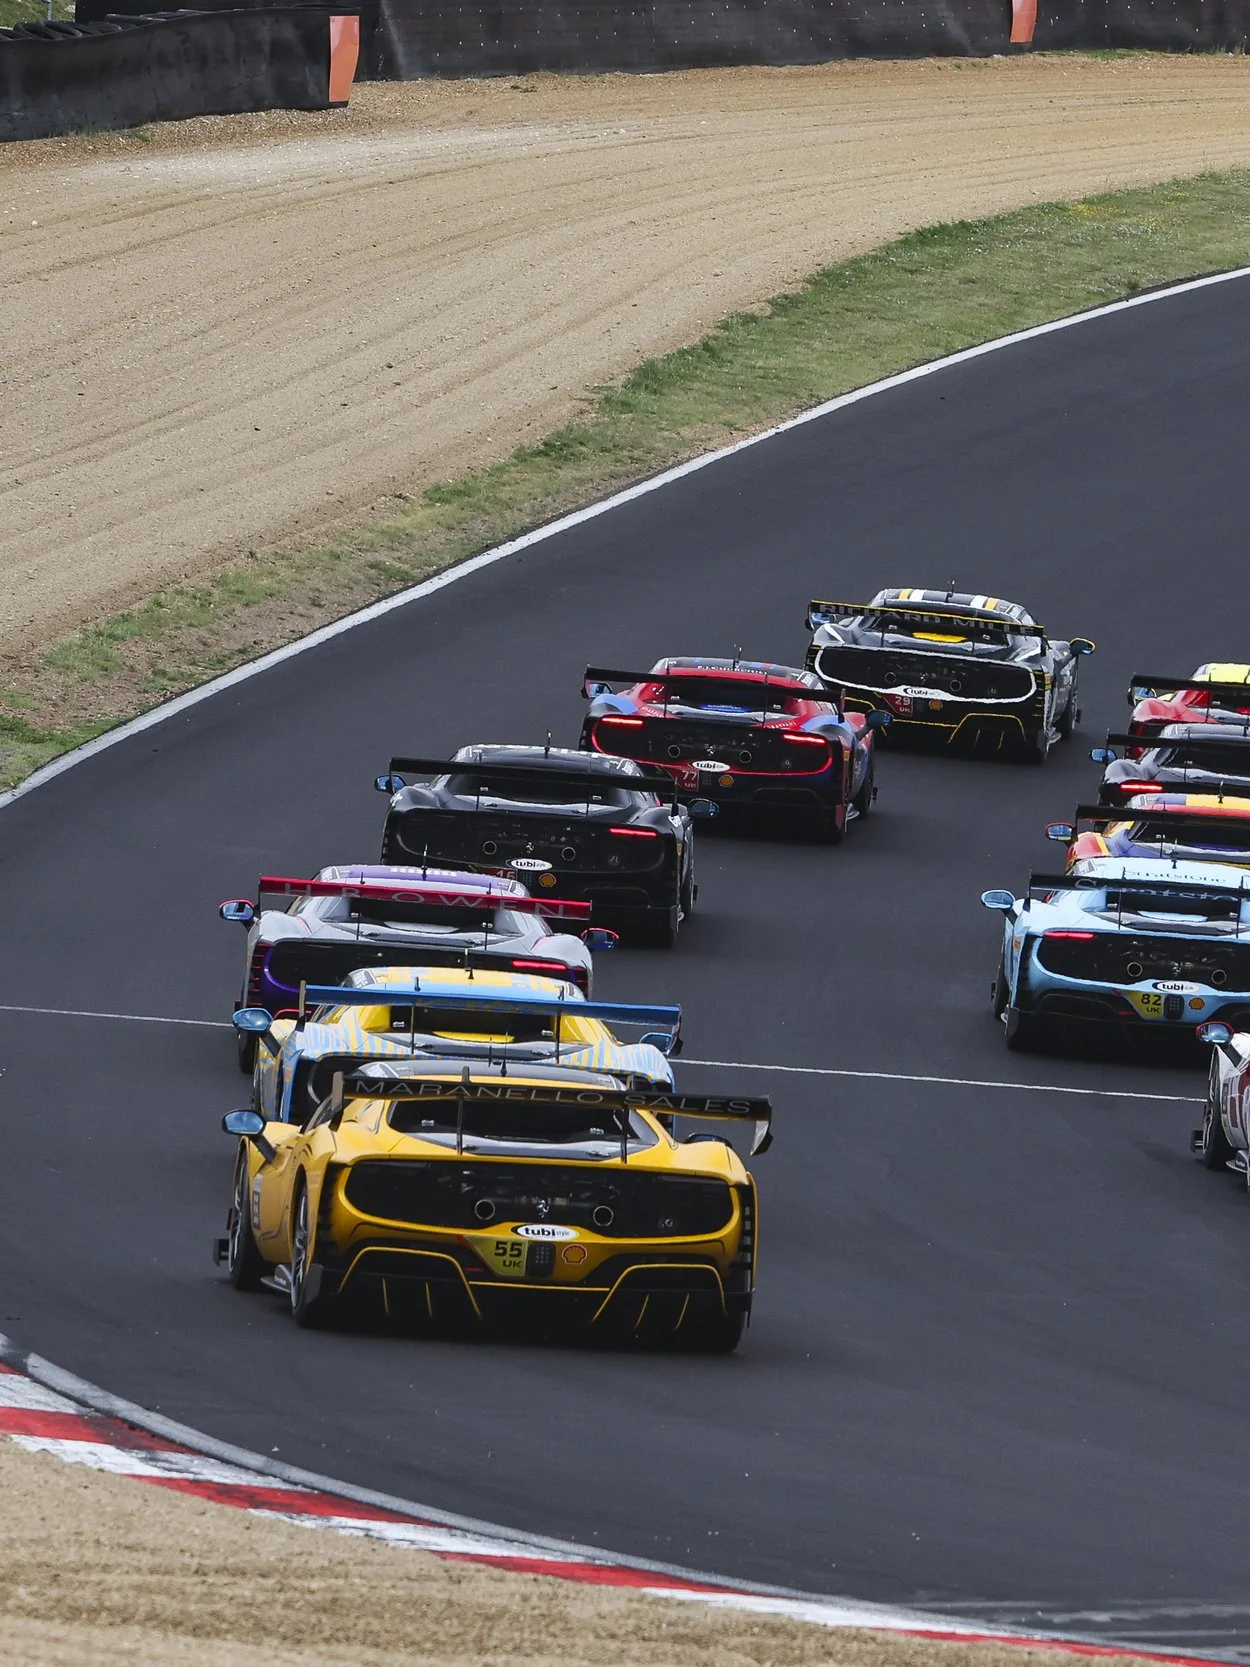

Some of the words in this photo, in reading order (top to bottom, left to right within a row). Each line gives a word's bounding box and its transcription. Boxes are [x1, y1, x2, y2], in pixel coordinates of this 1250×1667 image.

[819, 604, 941, 623] RICHARD
[952, 618, 1034, 635] MILLE
[894, 696, 911, 706] 29
[682, 770, 697, 780] 77
[515, 860, 536, 868] tubi
[1162, 983, 1184, 991] tubi
[1140, 993, 1162, 1006] 82
[355, 1080, 604, 1105] MARANELLO
[624, 1094, 750, 1114] SALES
[524, 1227, 556, 1237] tubi
[494, 1240, 522, 1258] 55
[502, 1260, 522, 1268] UK
